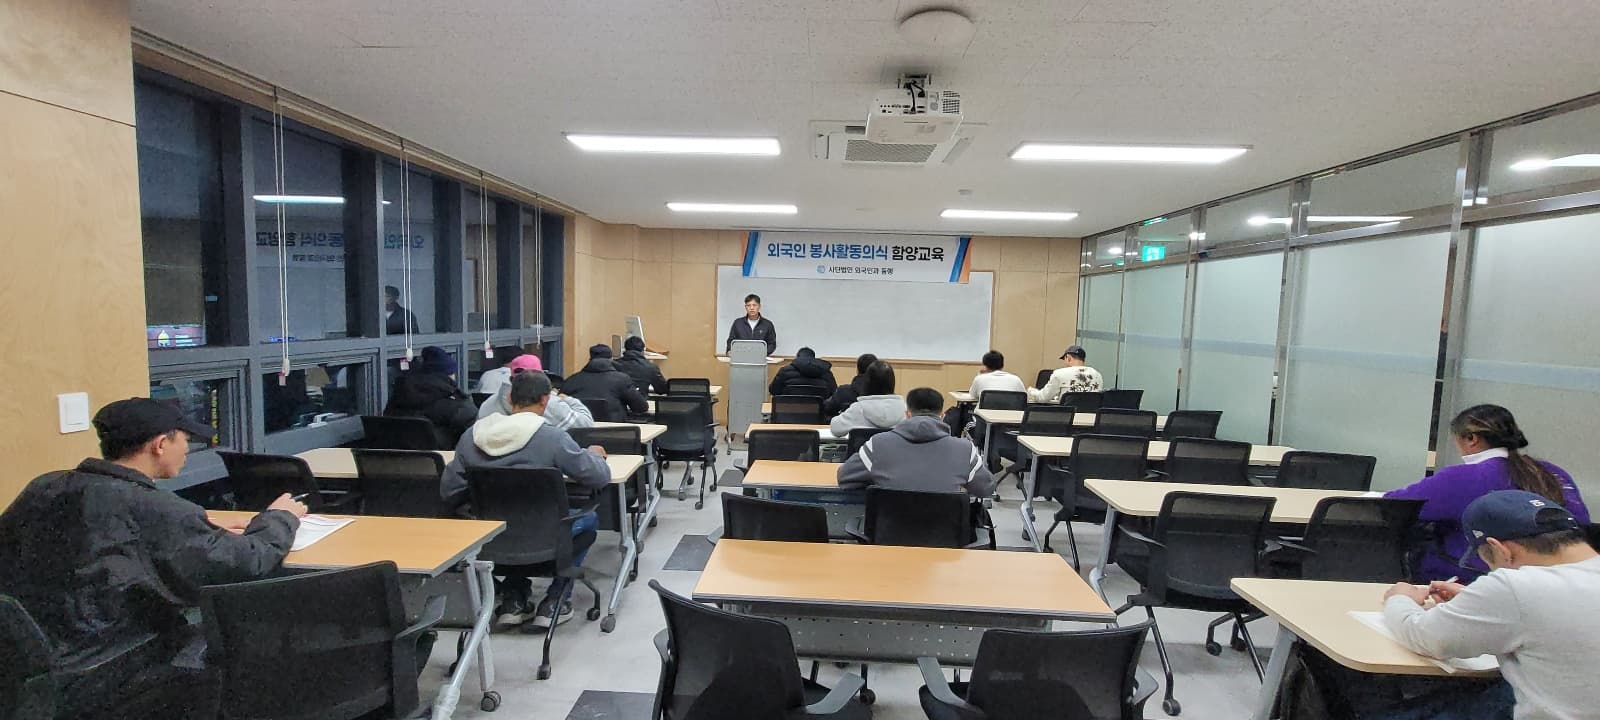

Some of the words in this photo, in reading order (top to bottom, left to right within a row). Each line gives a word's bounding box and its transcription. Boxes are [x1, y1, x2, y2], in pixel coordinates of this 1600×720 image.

[767, 242, 806, 259] 외국인
[809, 243, 888, 260] 봉사활동의식
[891, 245, 945, 262] 함양교육
[828, 266, 853, 274] 사단법인
[854, 266, 879, 275] 외국인과
